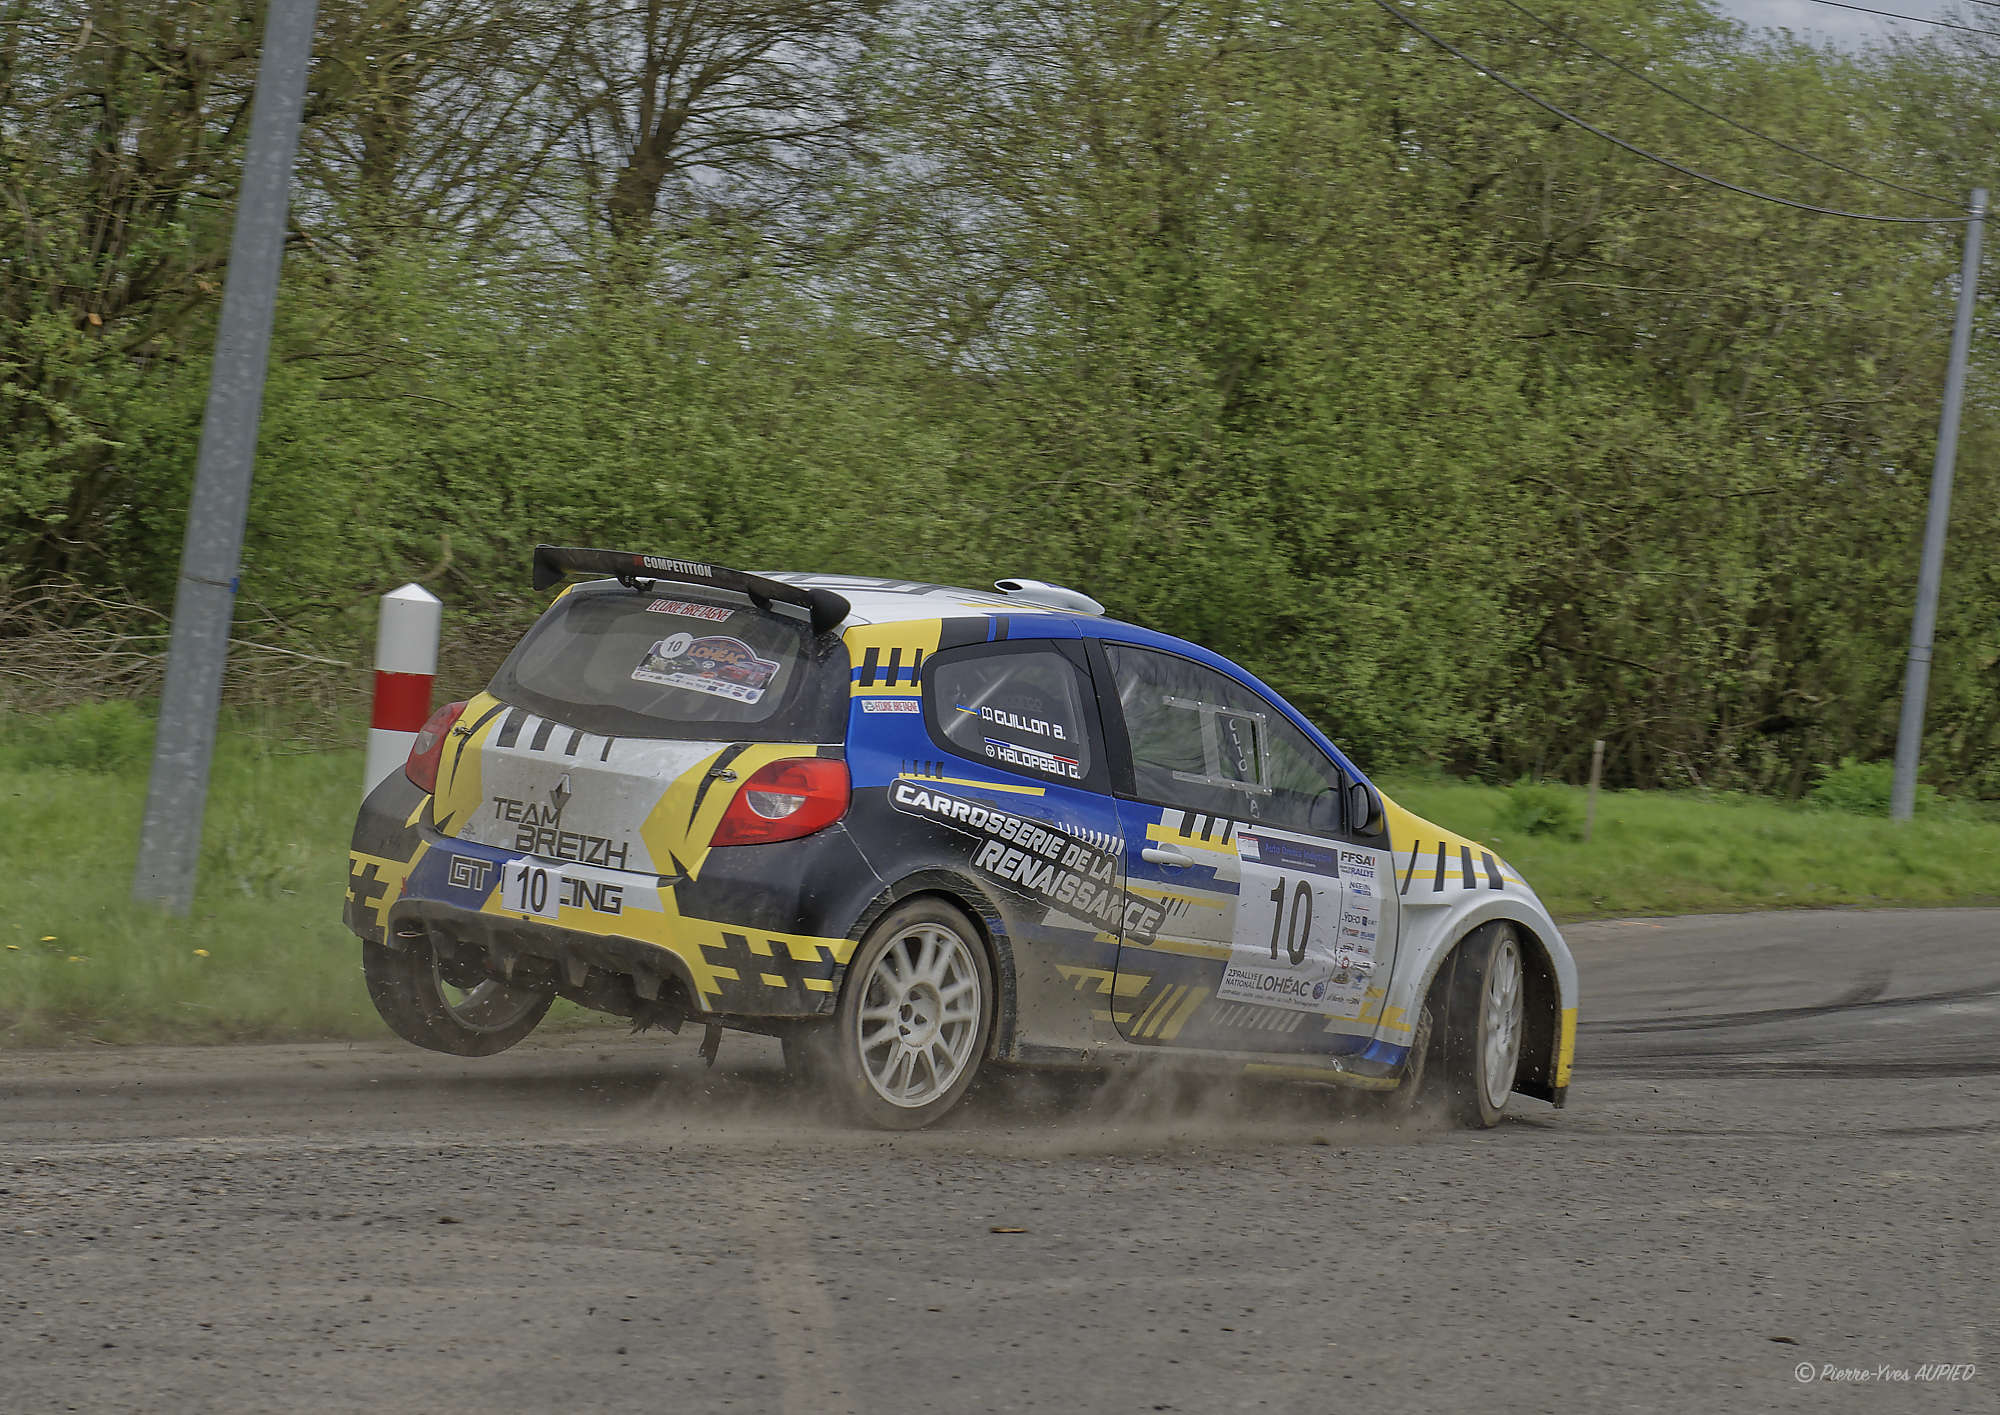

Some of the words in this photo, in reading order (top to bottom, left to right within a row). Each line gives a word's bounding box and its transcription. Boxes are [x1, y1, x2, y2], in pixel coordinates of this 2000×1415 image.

[643, 556, 713, 578] COMPETITION
[681, 603, 729, 620] BRETAGNE
[668, 640, 683, 652] 10
[494, 796, 562, 829] TEAM
[895, 785, 1066, 860] CARROSSERIE
[1061, 843, 1092, 873] DE
[1089, 856, 1113, 884] LA
[515, 824, 628, 869] BREIZH
[1341, 851, 1372, 866] FFSA
[448, 854, 494, 892] GT
[1350, 867, 1374, 878] RALLYE
[516, 866, 548, 913] 10
[975, 839, 1161, 937] RENAISSANCE
[1270, 876, 1313, 965] 10
[1225, 977, 1255, 989] NATIONAL
[1235, 969, 1258, 981] RALLYE
[1256, 974, 1311, 997] LOHÉAC
